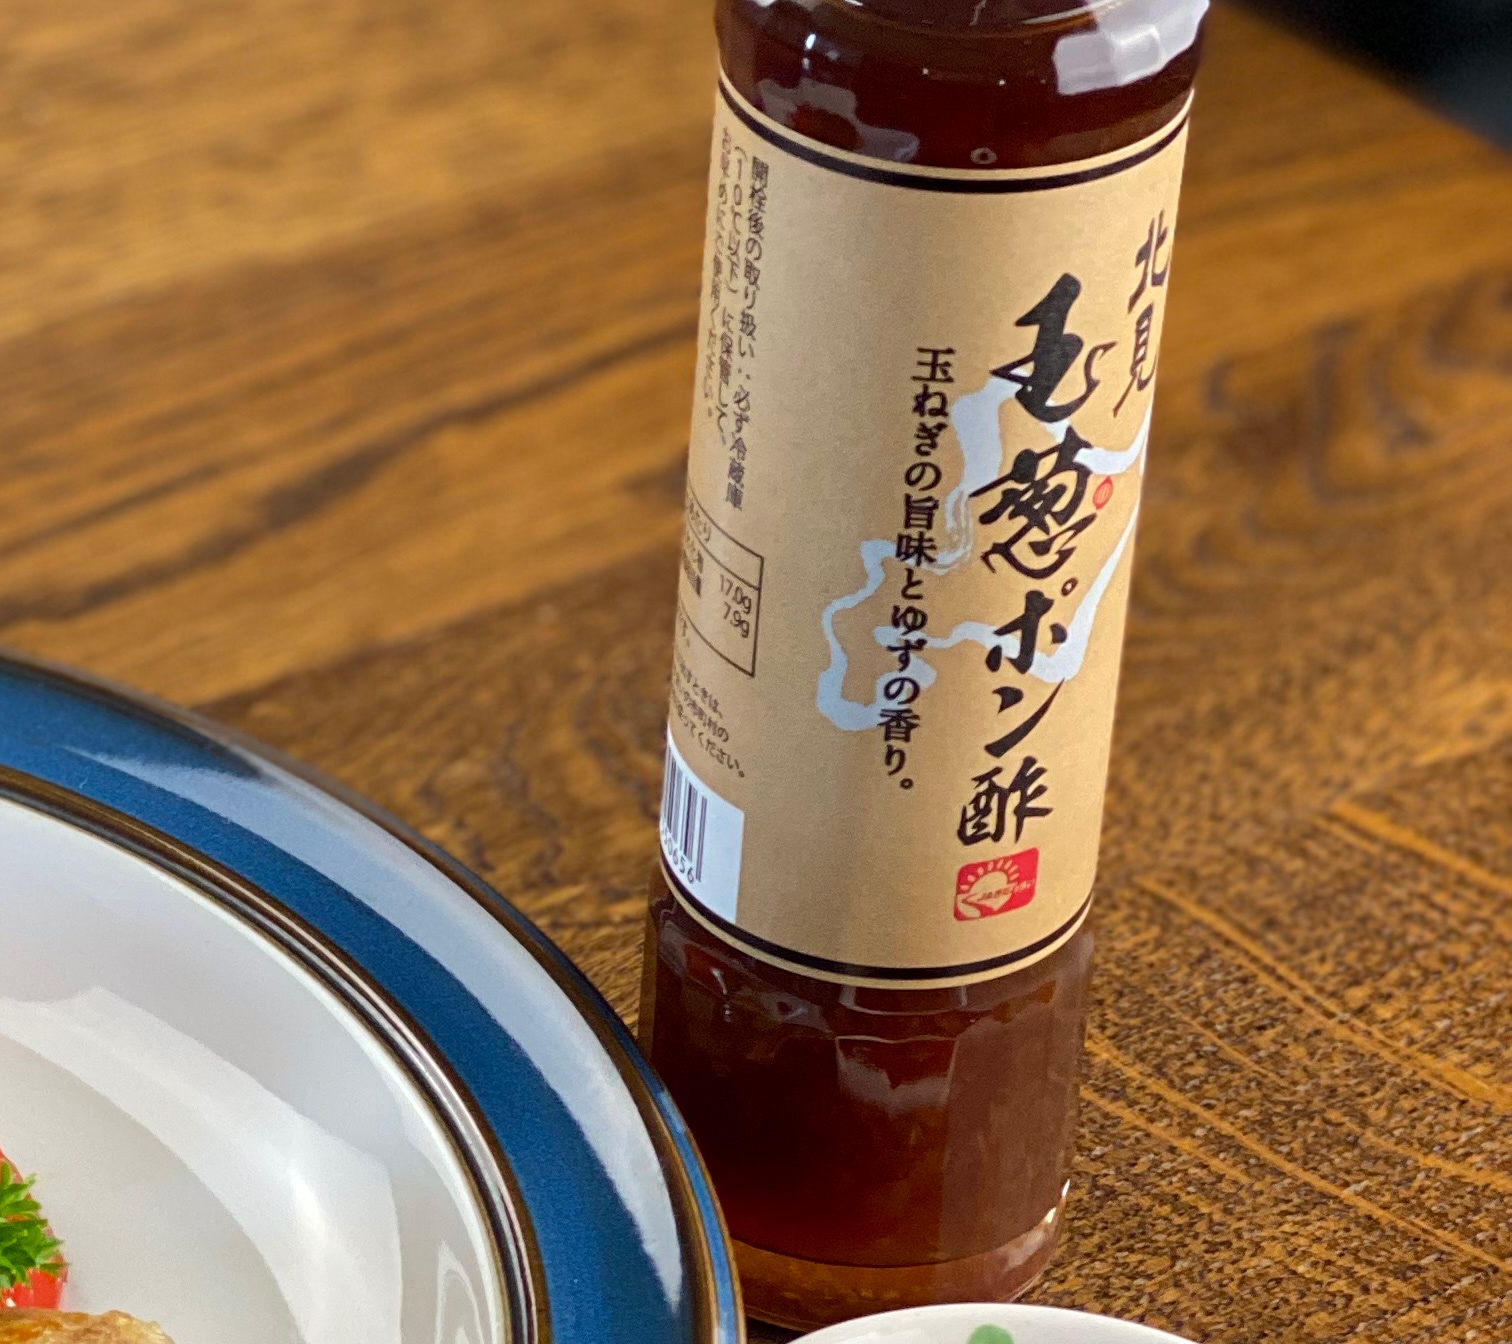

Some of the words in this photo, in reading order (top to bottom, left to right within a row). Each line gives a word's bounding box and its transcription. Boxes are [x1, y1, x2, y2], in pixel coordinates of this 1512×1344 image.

[1113, 208, 1172, 419] 北見
[876, 347, 956, 791] 玉ねぎの旨味とゆずの香り。
[957, 272, 1118, 847] 玉葱ポン酢
